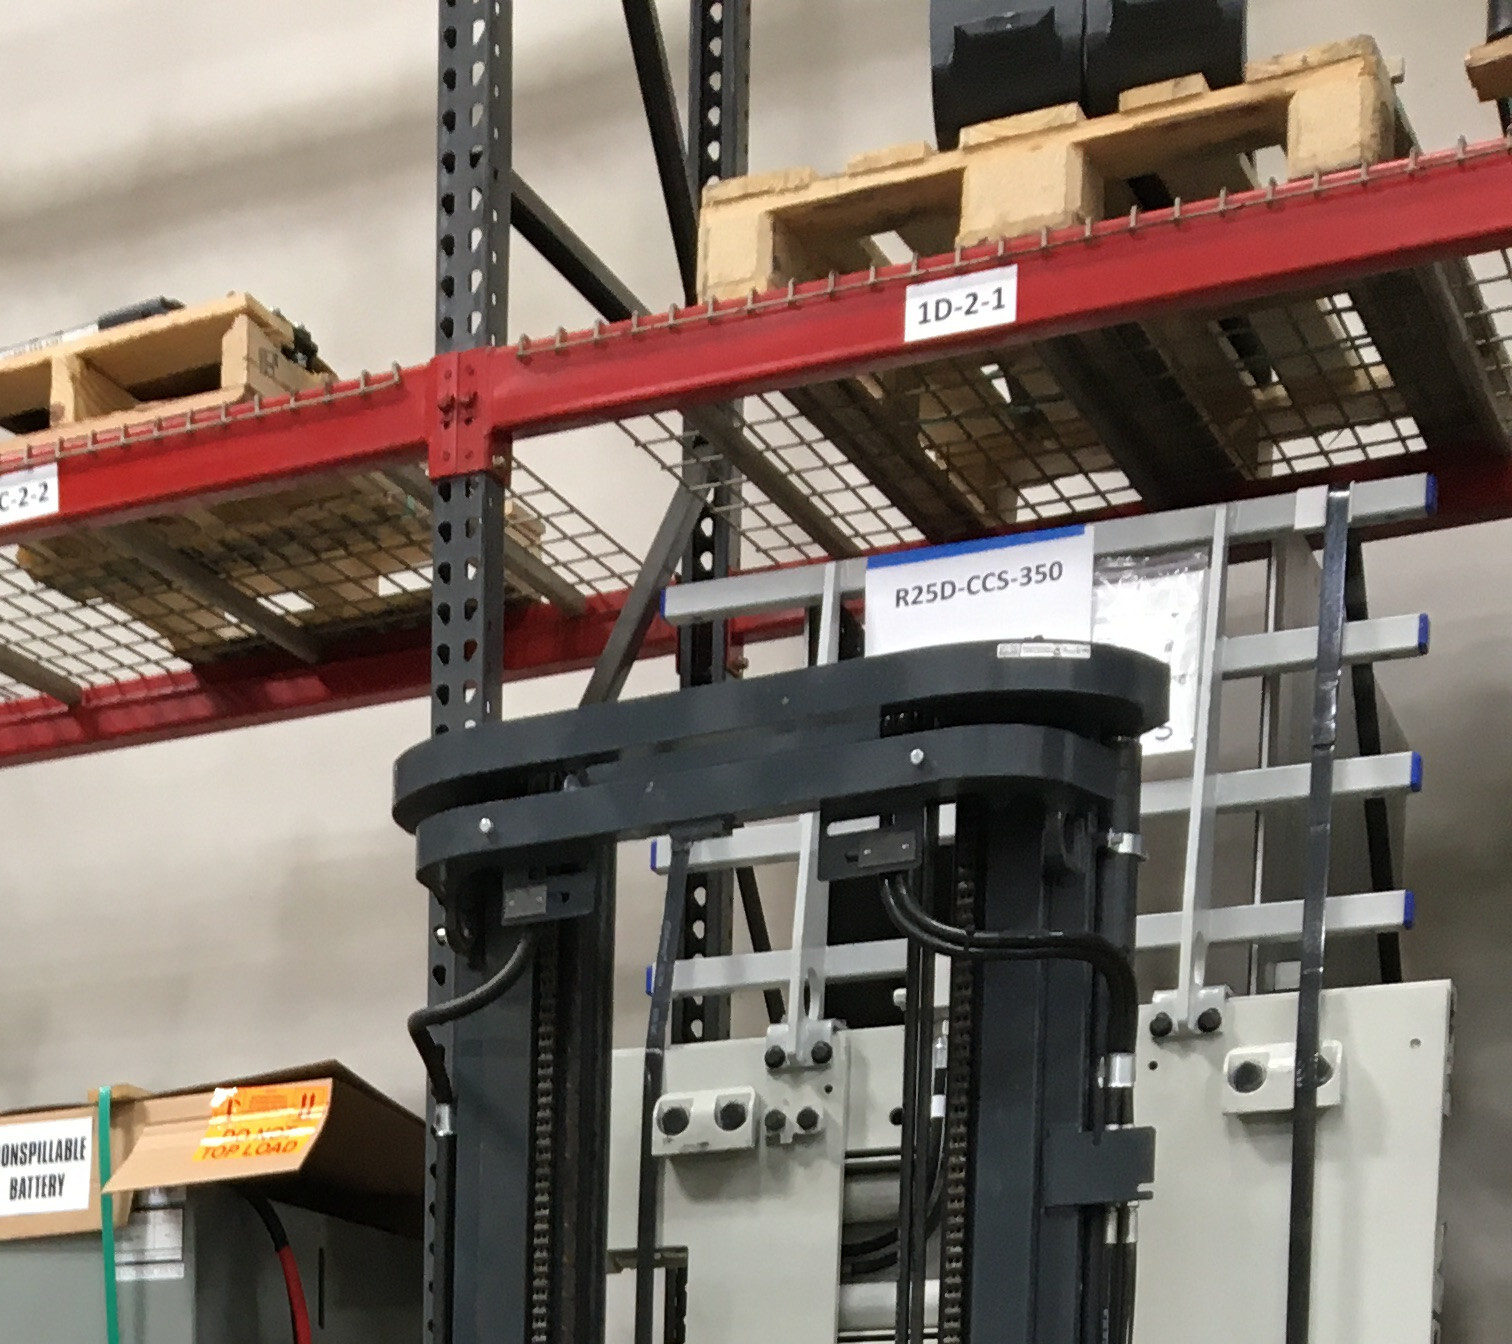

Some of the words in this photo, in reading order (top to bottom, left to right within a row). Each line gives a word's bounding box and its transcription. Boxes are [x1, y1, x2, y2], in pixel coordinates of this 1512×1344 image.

[918, 286, 1006, 326] 1D-2-1
[894, 560, 1065, 609] R25D-CCS-350
[202, 1145, 240, 1160] TOP
[242, 1141, 299, 1156] LOAD
[8, 1172, 66, 1202] BATTERY
